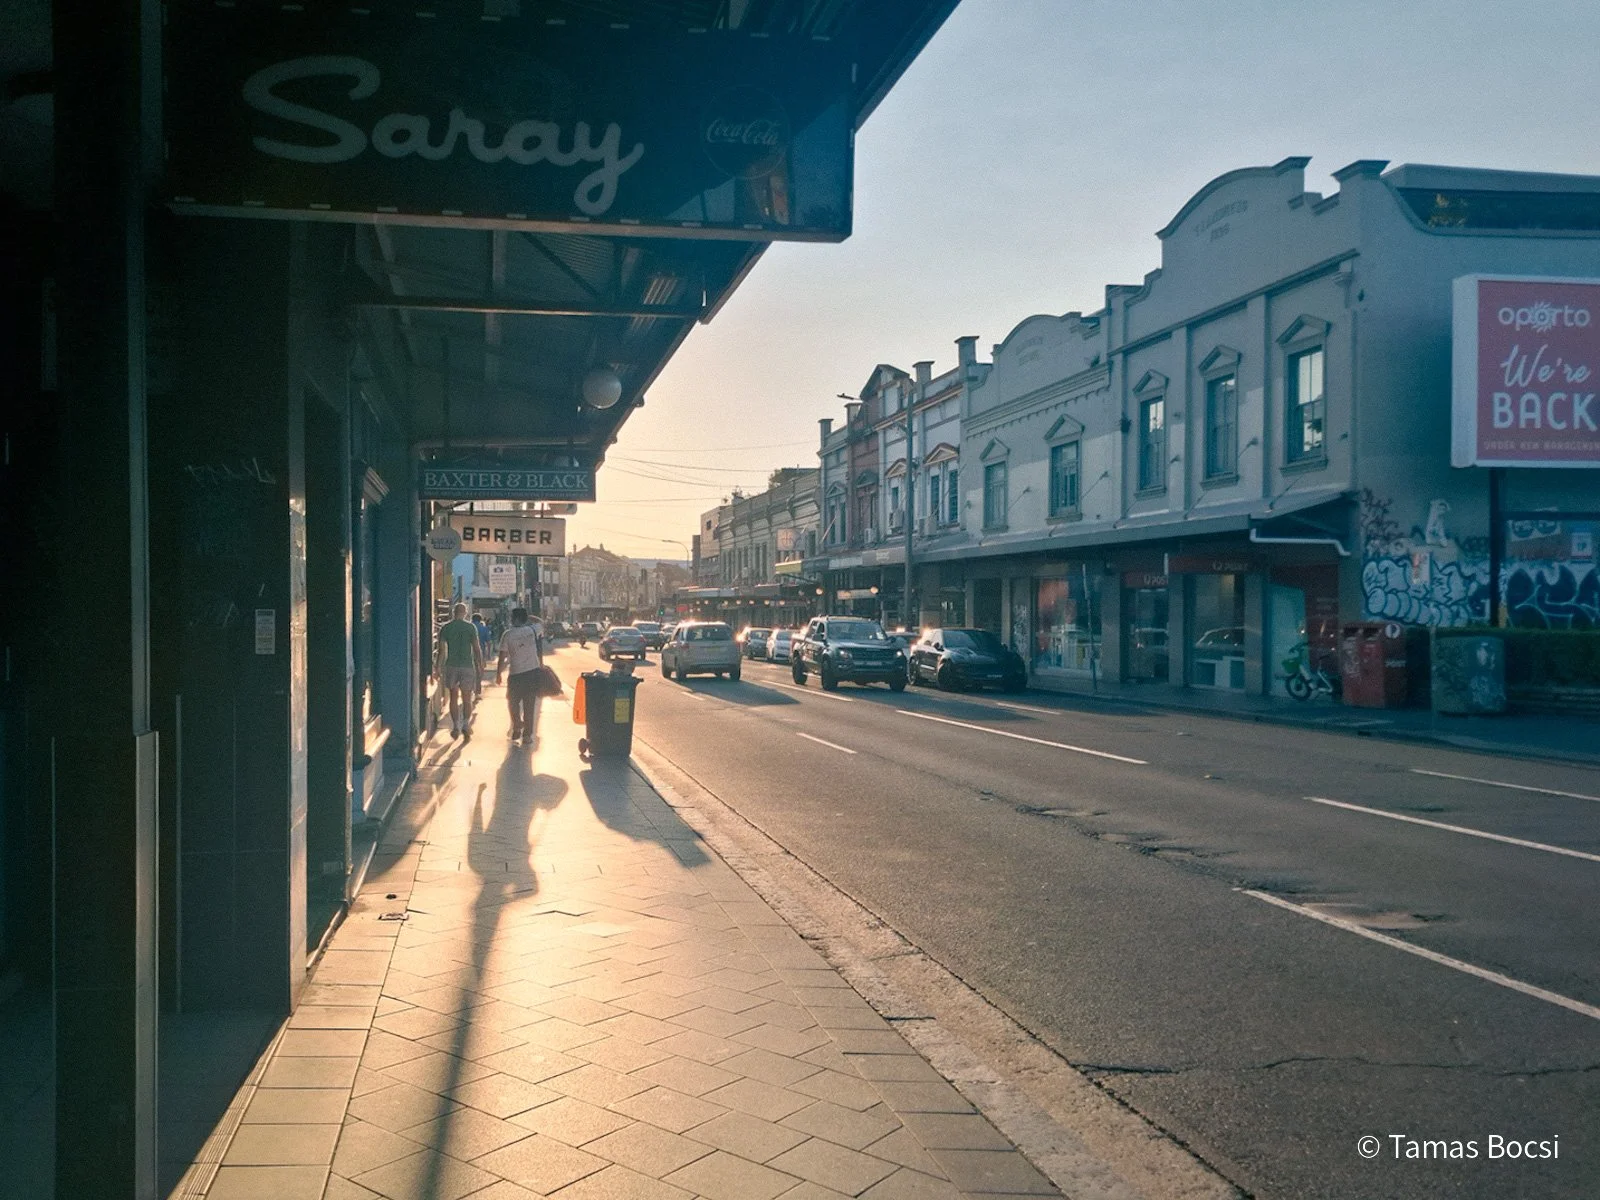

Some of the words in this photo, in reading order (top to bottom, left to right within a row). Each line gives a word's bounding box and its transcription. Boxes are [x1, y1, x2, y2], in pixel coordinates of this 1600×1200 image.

[243, 55, 644, 214] Saray
[1498, 302, 1591, 332] oporto
[1500, 344, 1591, 387] We're
[1492, 392, 1598, 432] BACK
[424, 471, 501, 488] BAXTER
[506, 472, 521, 487] &
[526, 473, 588, 488] BLACK
[462, 526, 553, 545] BARBER
